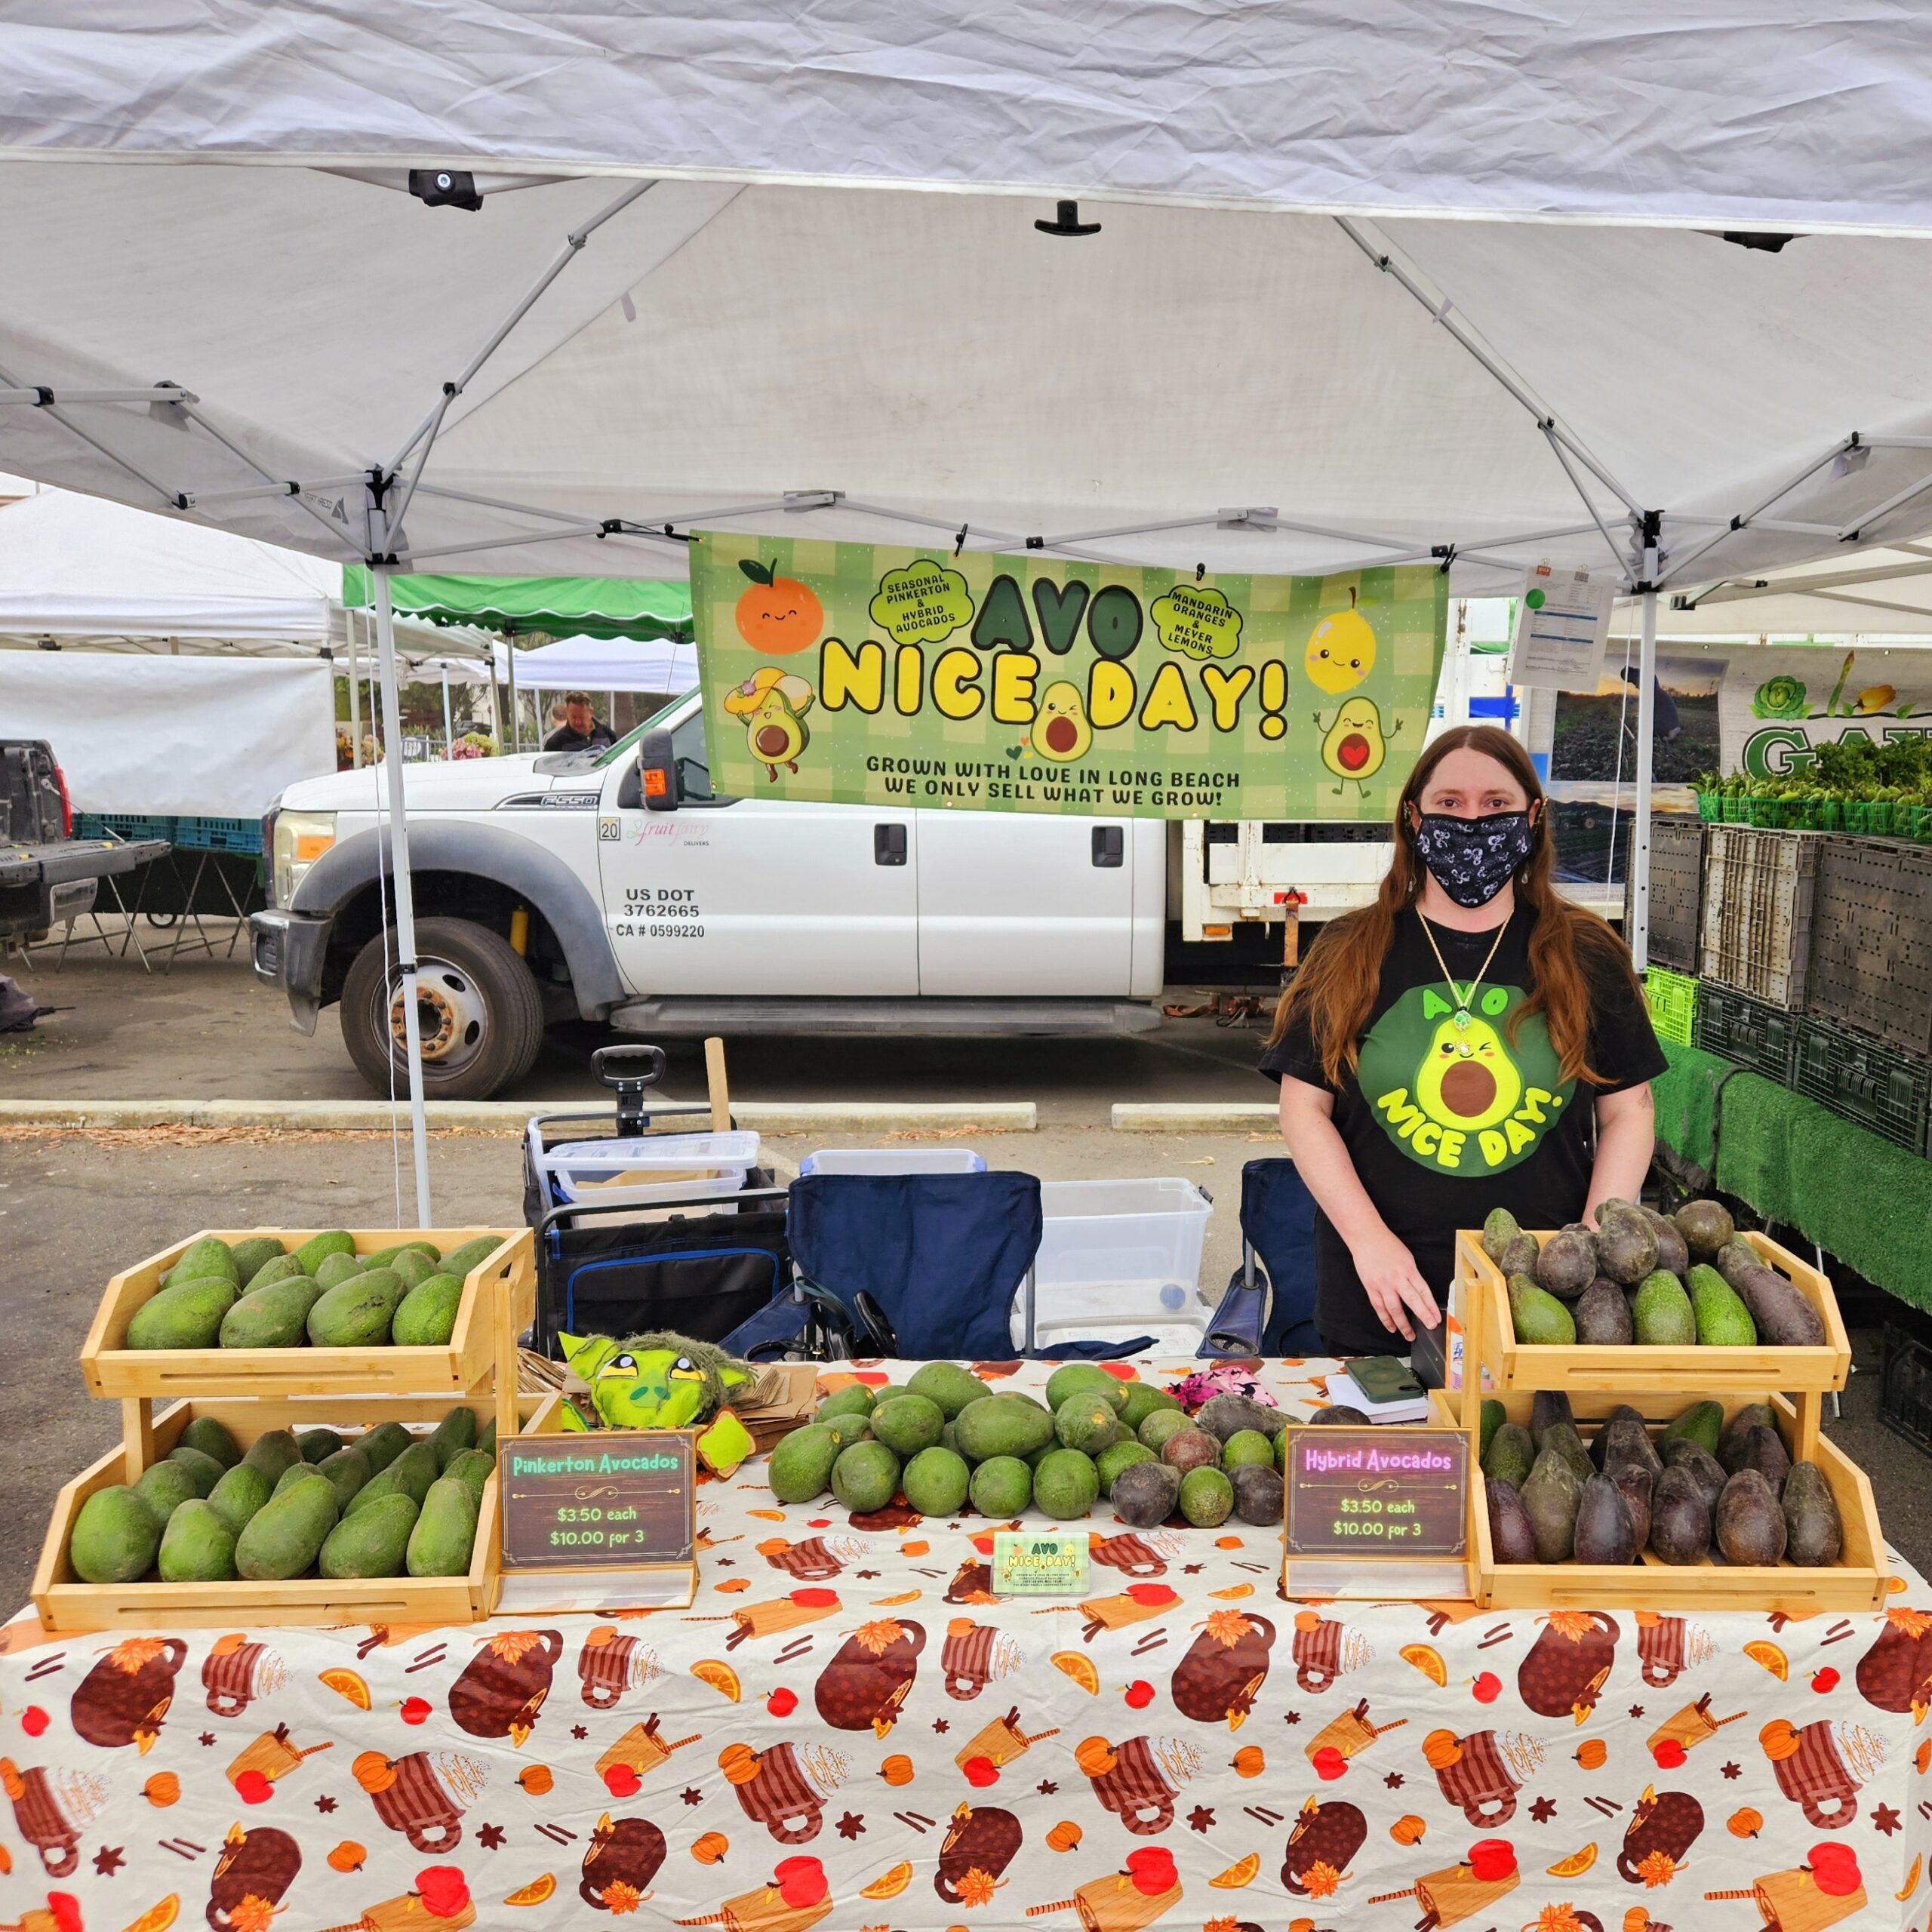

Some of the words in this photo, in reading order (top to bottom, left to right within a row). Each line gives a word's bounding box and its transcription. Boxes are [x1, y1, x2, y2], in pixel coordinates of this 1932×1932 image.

[888, 574, 945, 593] SEASONAL
[886, 583, 950, 604] PINKERTON
[902, 605, 944, 621] HYBRID
[917, 599, 924, 608] &
[1171, 592, 1232, 619] MANDARIN
[896, 613, 955, 633] AVOCADOS
[971, 573, 1144, 661] AVO
[1173, 603, 1226, 627] ORANGES
[1192, 620, 1199, 629] &
[1168, 632, 1213, 654] LEMONS
[1175, 624, 1213, 644] MEYER
[820, 637, 1041, 724] NICE
[1087, 657, 1288, 740] DAY!
[866, 756, 946, 776] GROWN
[955, 762, 1010, 779] WITH
[1020, 766, 1070, 783] LOVE
[1079, 769, 1100, 784] IN
[1109, 771, 1162, 786] LONG
[1171, 772, 1239, 787] BEACH
[885, 777, 916, 794] WE
[925, 780, 980, 796] ONLY
[988, 783, 1035, 799] SELL
[1044, 786, 1104, 803] WHAT
[1112, 789, 1143, 804] WE
[1152, 792, 1223, 806] GROW!
[601, 823, 618, 838] 20
[626, 889, 651, 900] US
[658, 890, 694, 901] DOT
[624, 904, 700, 917] 3762665
[616, 924, 634, 936] CA
[638, 924, 646, 935] #
[651, 925, 705, 937] 0599220
[1423, 982, 1509, 1020] AVO
[1377, 1088, 1467, 1168] NICE
[513, 1455, 595, 1476] Pinkerton
[599, 1454, 678, 1474] Avocados
[1306, 1449, 1362, 1471] Hybrid
[1367, 1449, 1451, 1471] Avocados
[557, 1507, 601, 1521] $3.50
[607, 1506, 636, 1521] each
[1341, 1498, 1382, 1513] $3.50
[1387, 1500, 1415, 1513] each
[550, 1531, 604, 1546] $10.00
[609, 1533, 629, 1548] for
[635, 1530, 644, 1543] 3
[1334, 1521, 1383, 1536] $10.00
[1388, 1524, 1407, 1540] for
[1412, 1523, 1421, 1536] 3
[1031, 1543, 1058, 1555] AVO
[1009, 1555, 1040, 1567] NICE
[1046, 1555, 1075, 1567] DAY!
